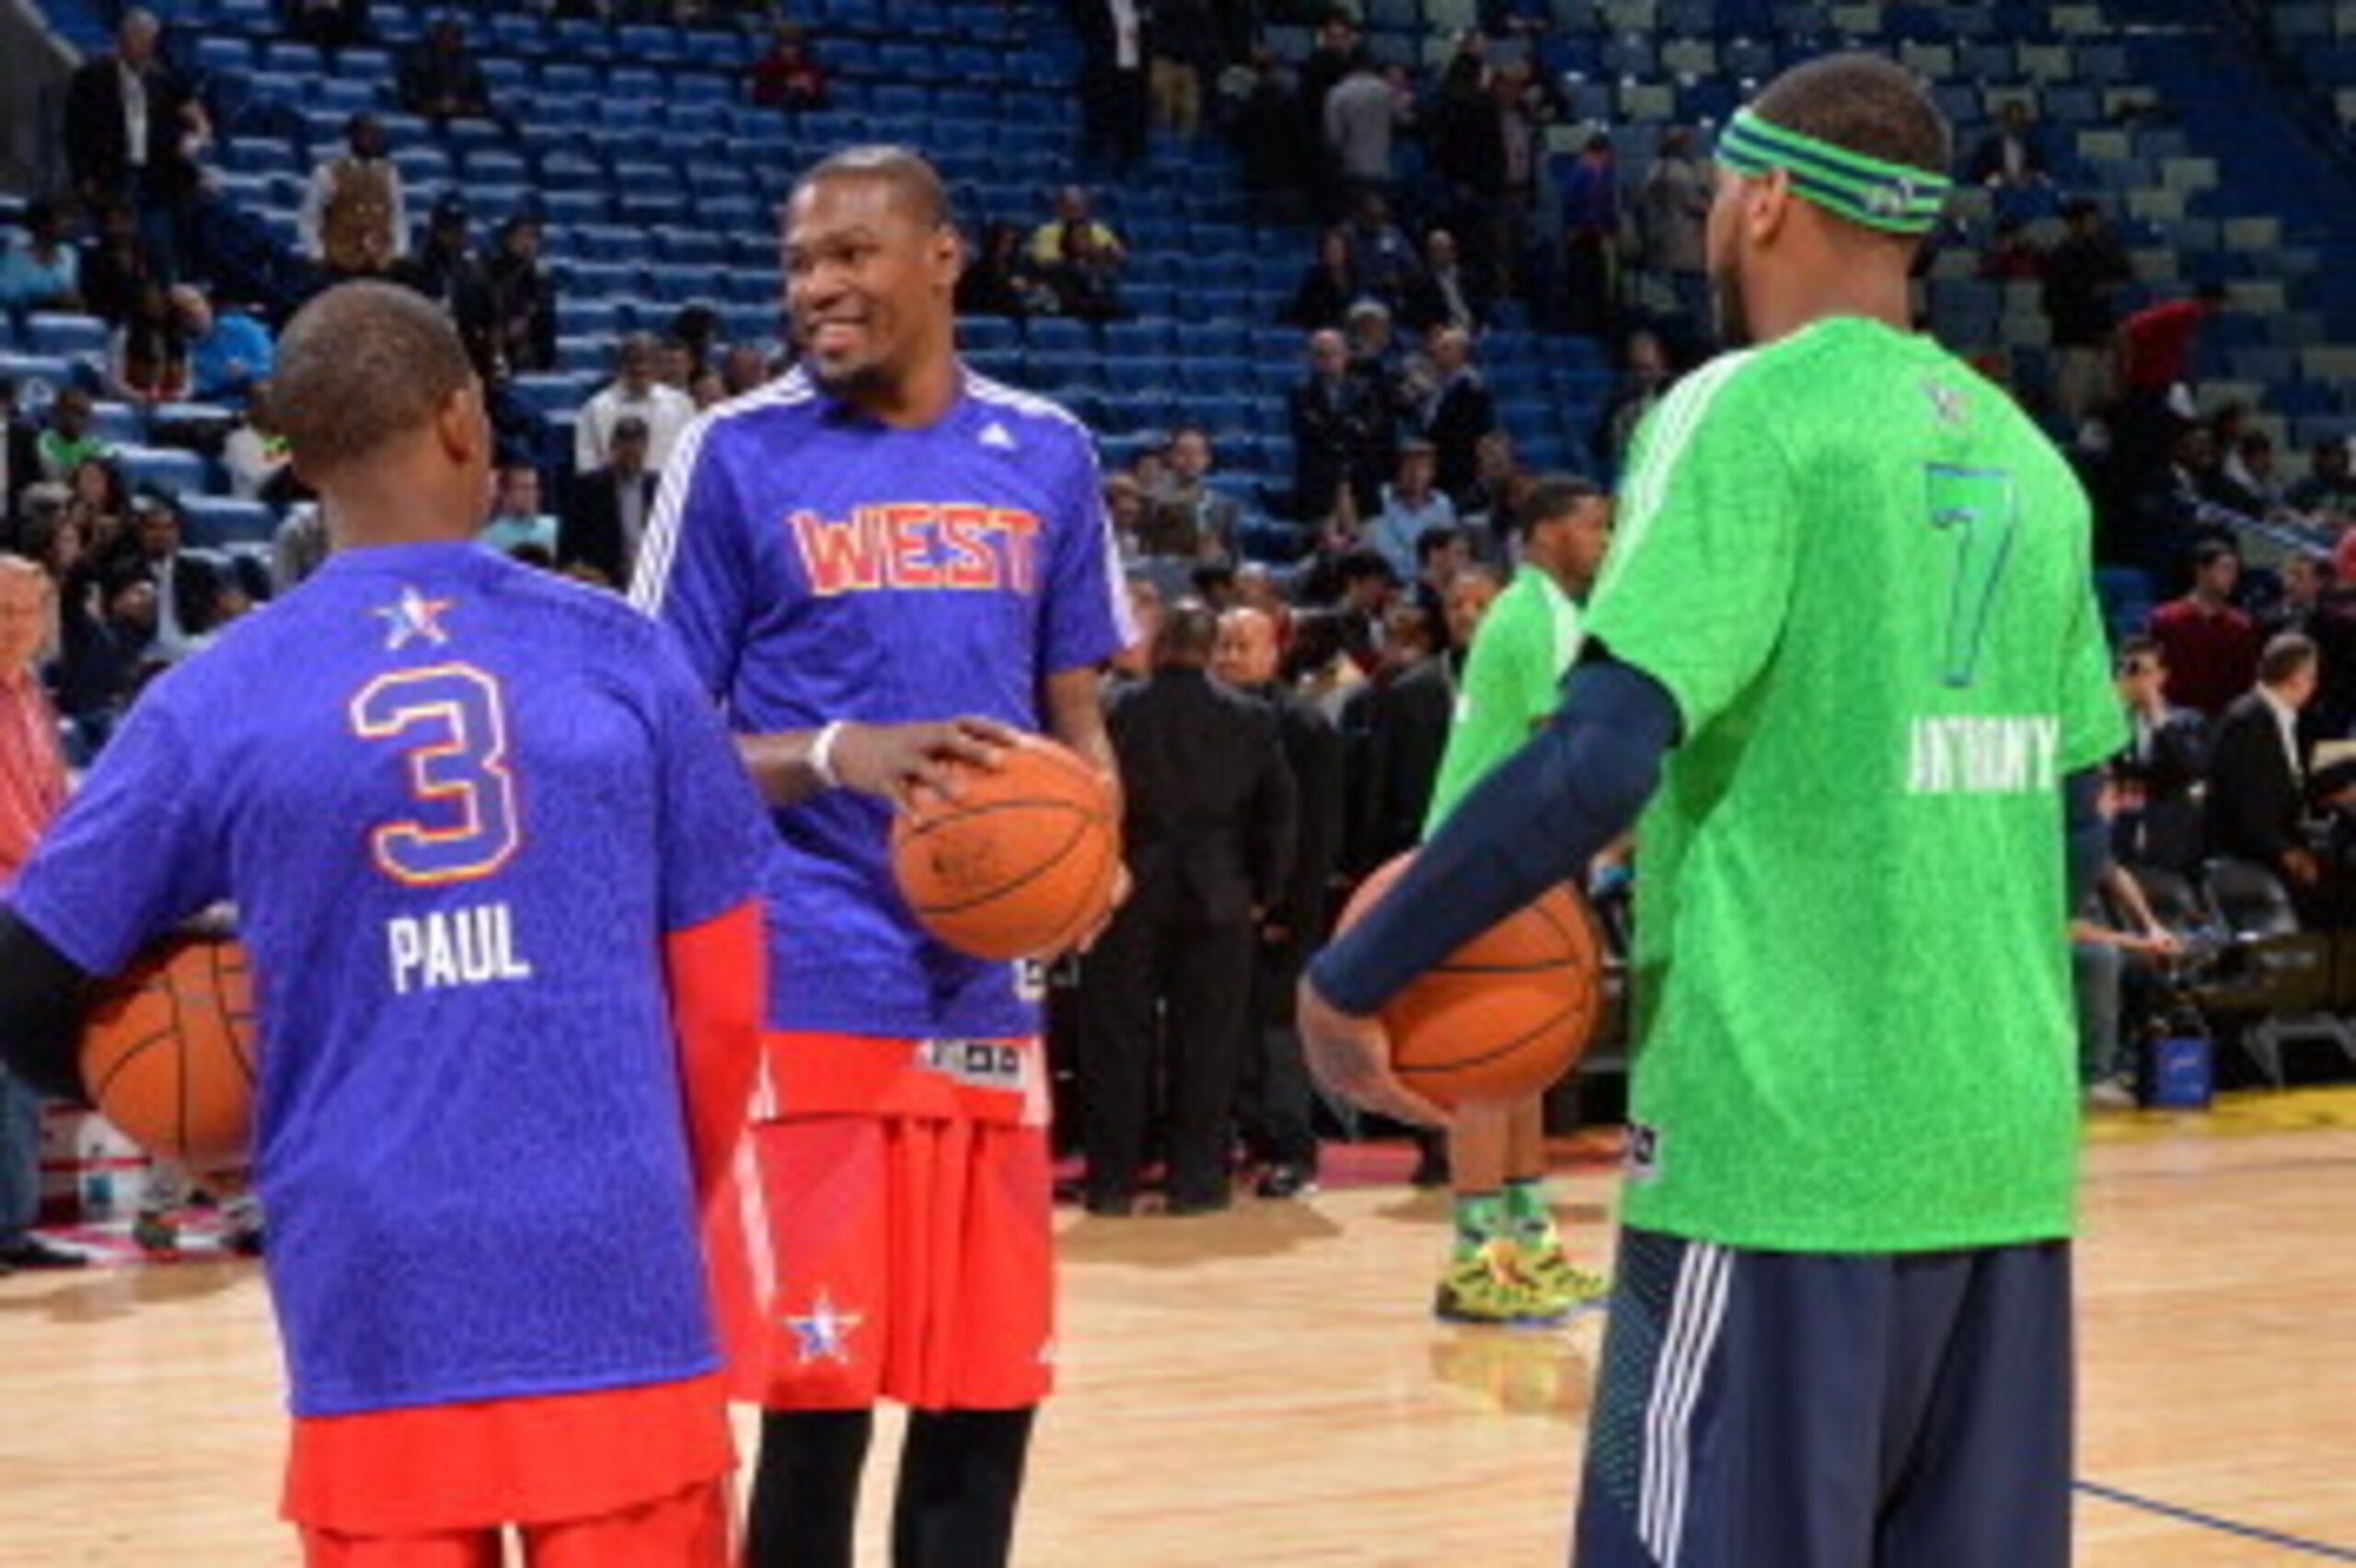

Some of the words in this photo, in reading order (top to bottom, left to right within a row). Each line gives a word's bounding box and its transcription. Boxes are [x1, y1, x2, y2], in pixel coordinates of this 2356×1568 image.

[786, 502, 1042, 598] WEST
[1924, 462, 2017, 688] 7
[349, 660, 521, 887] 3
[387, 903, 531, 995] PAUL
